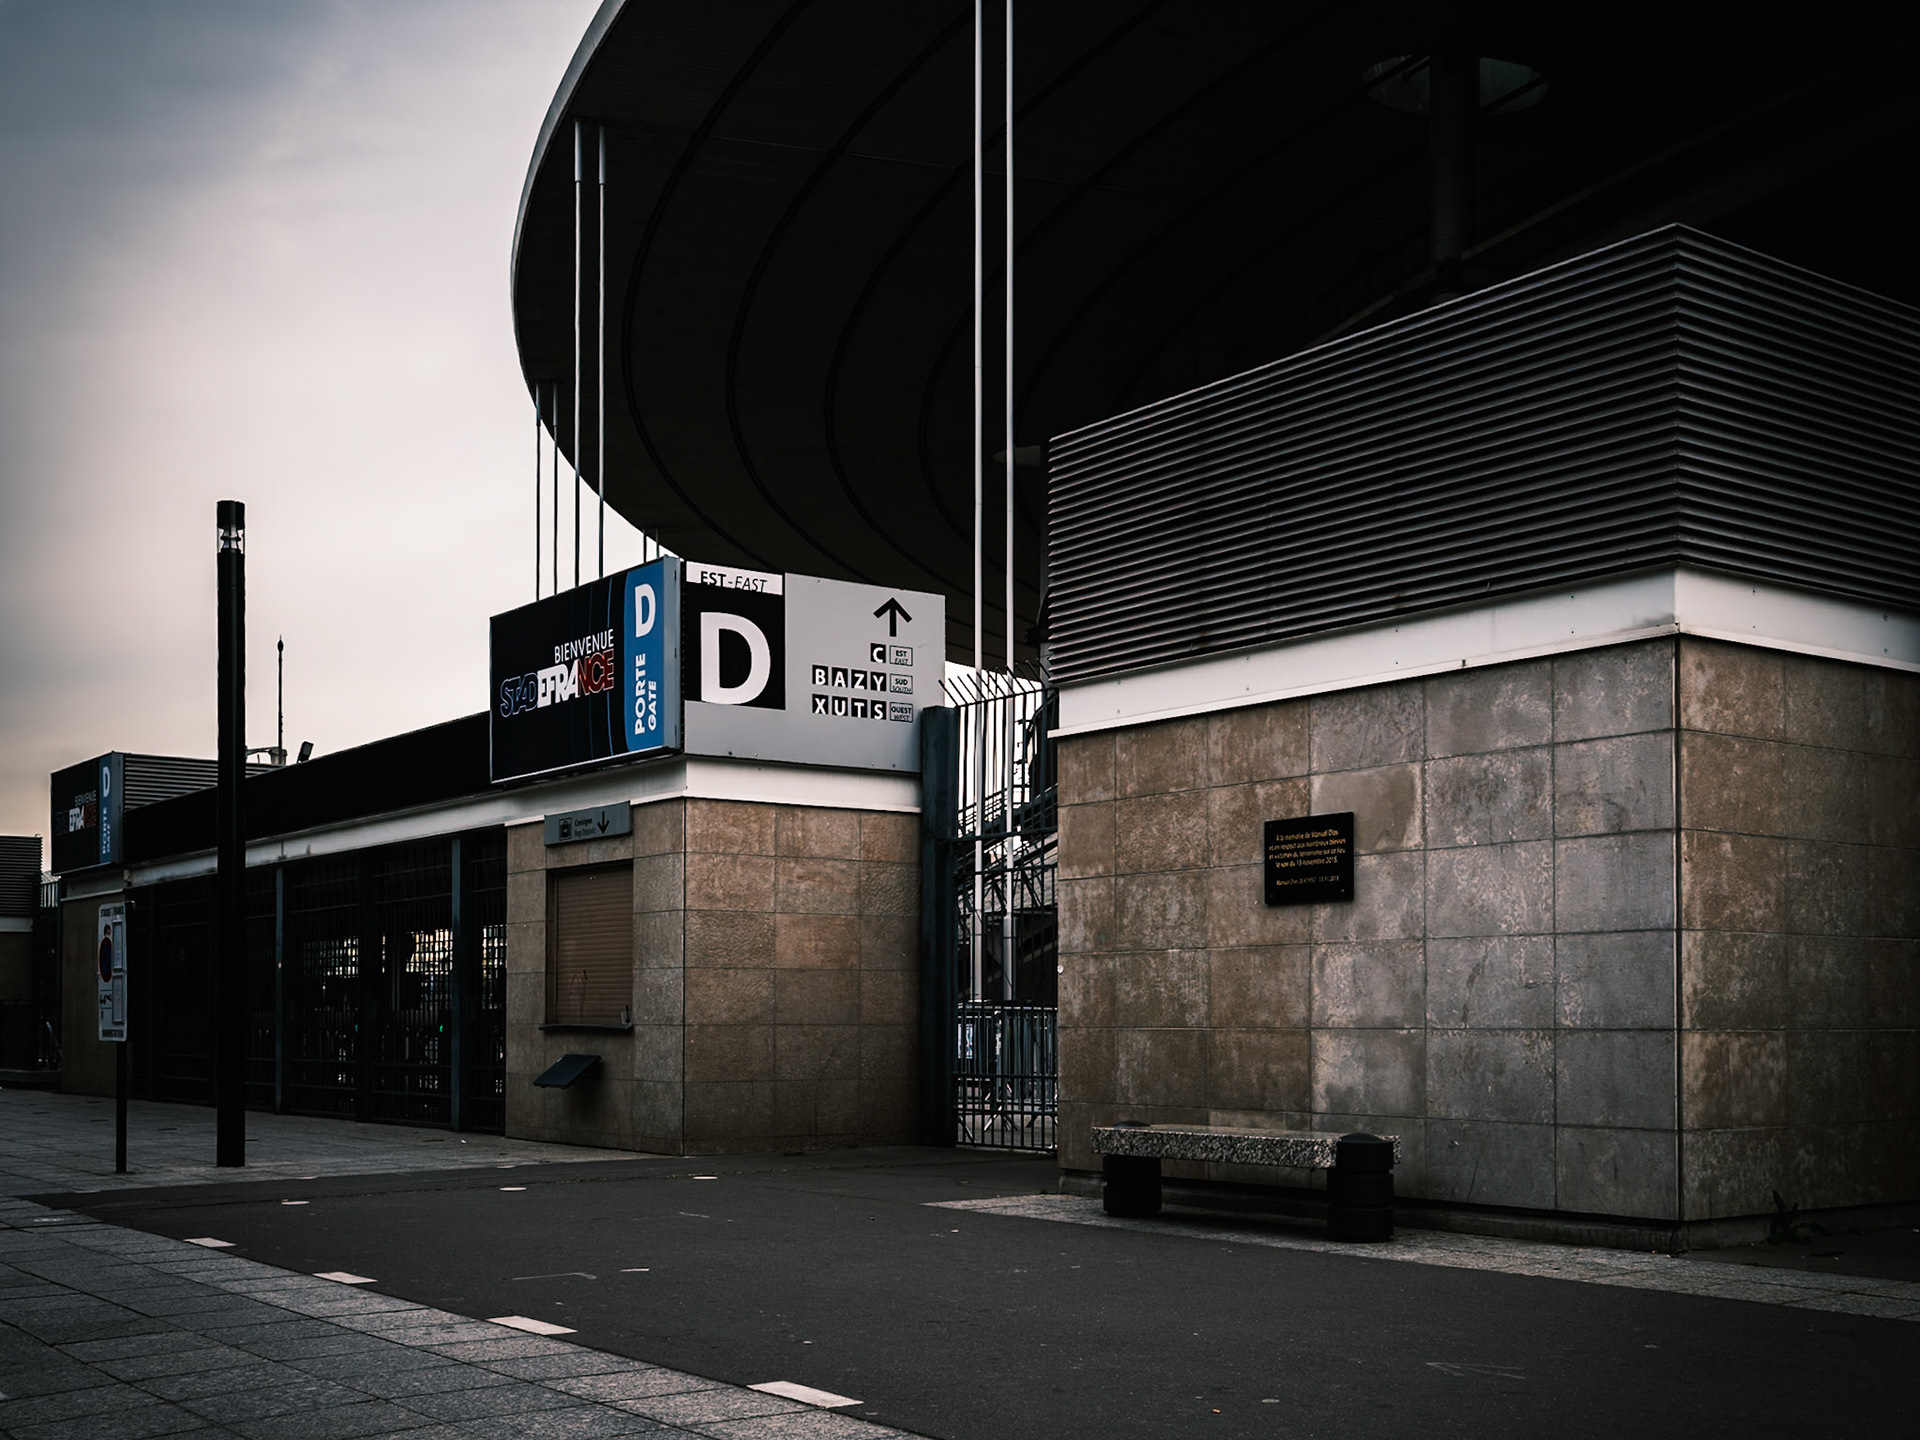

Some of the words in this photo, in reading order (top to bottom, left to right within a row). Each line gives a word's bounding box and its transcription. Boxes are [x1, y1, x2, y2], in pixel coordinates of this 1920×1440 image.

[634, 583, 656, 638] D
[554, 628, 615, 664] BIENVENUE
[700, 611, 771, 705] D
[872, 646, 884, 664] C
[895, 649, 908, 658] EST
[634, 653, 646, 735] PORTE
[894, 678, 909, 686] SUD
[648, 680, 657, 731] GATE
[891, 706, 912, 715] OUEST
[102, 766, 111, 798] D
